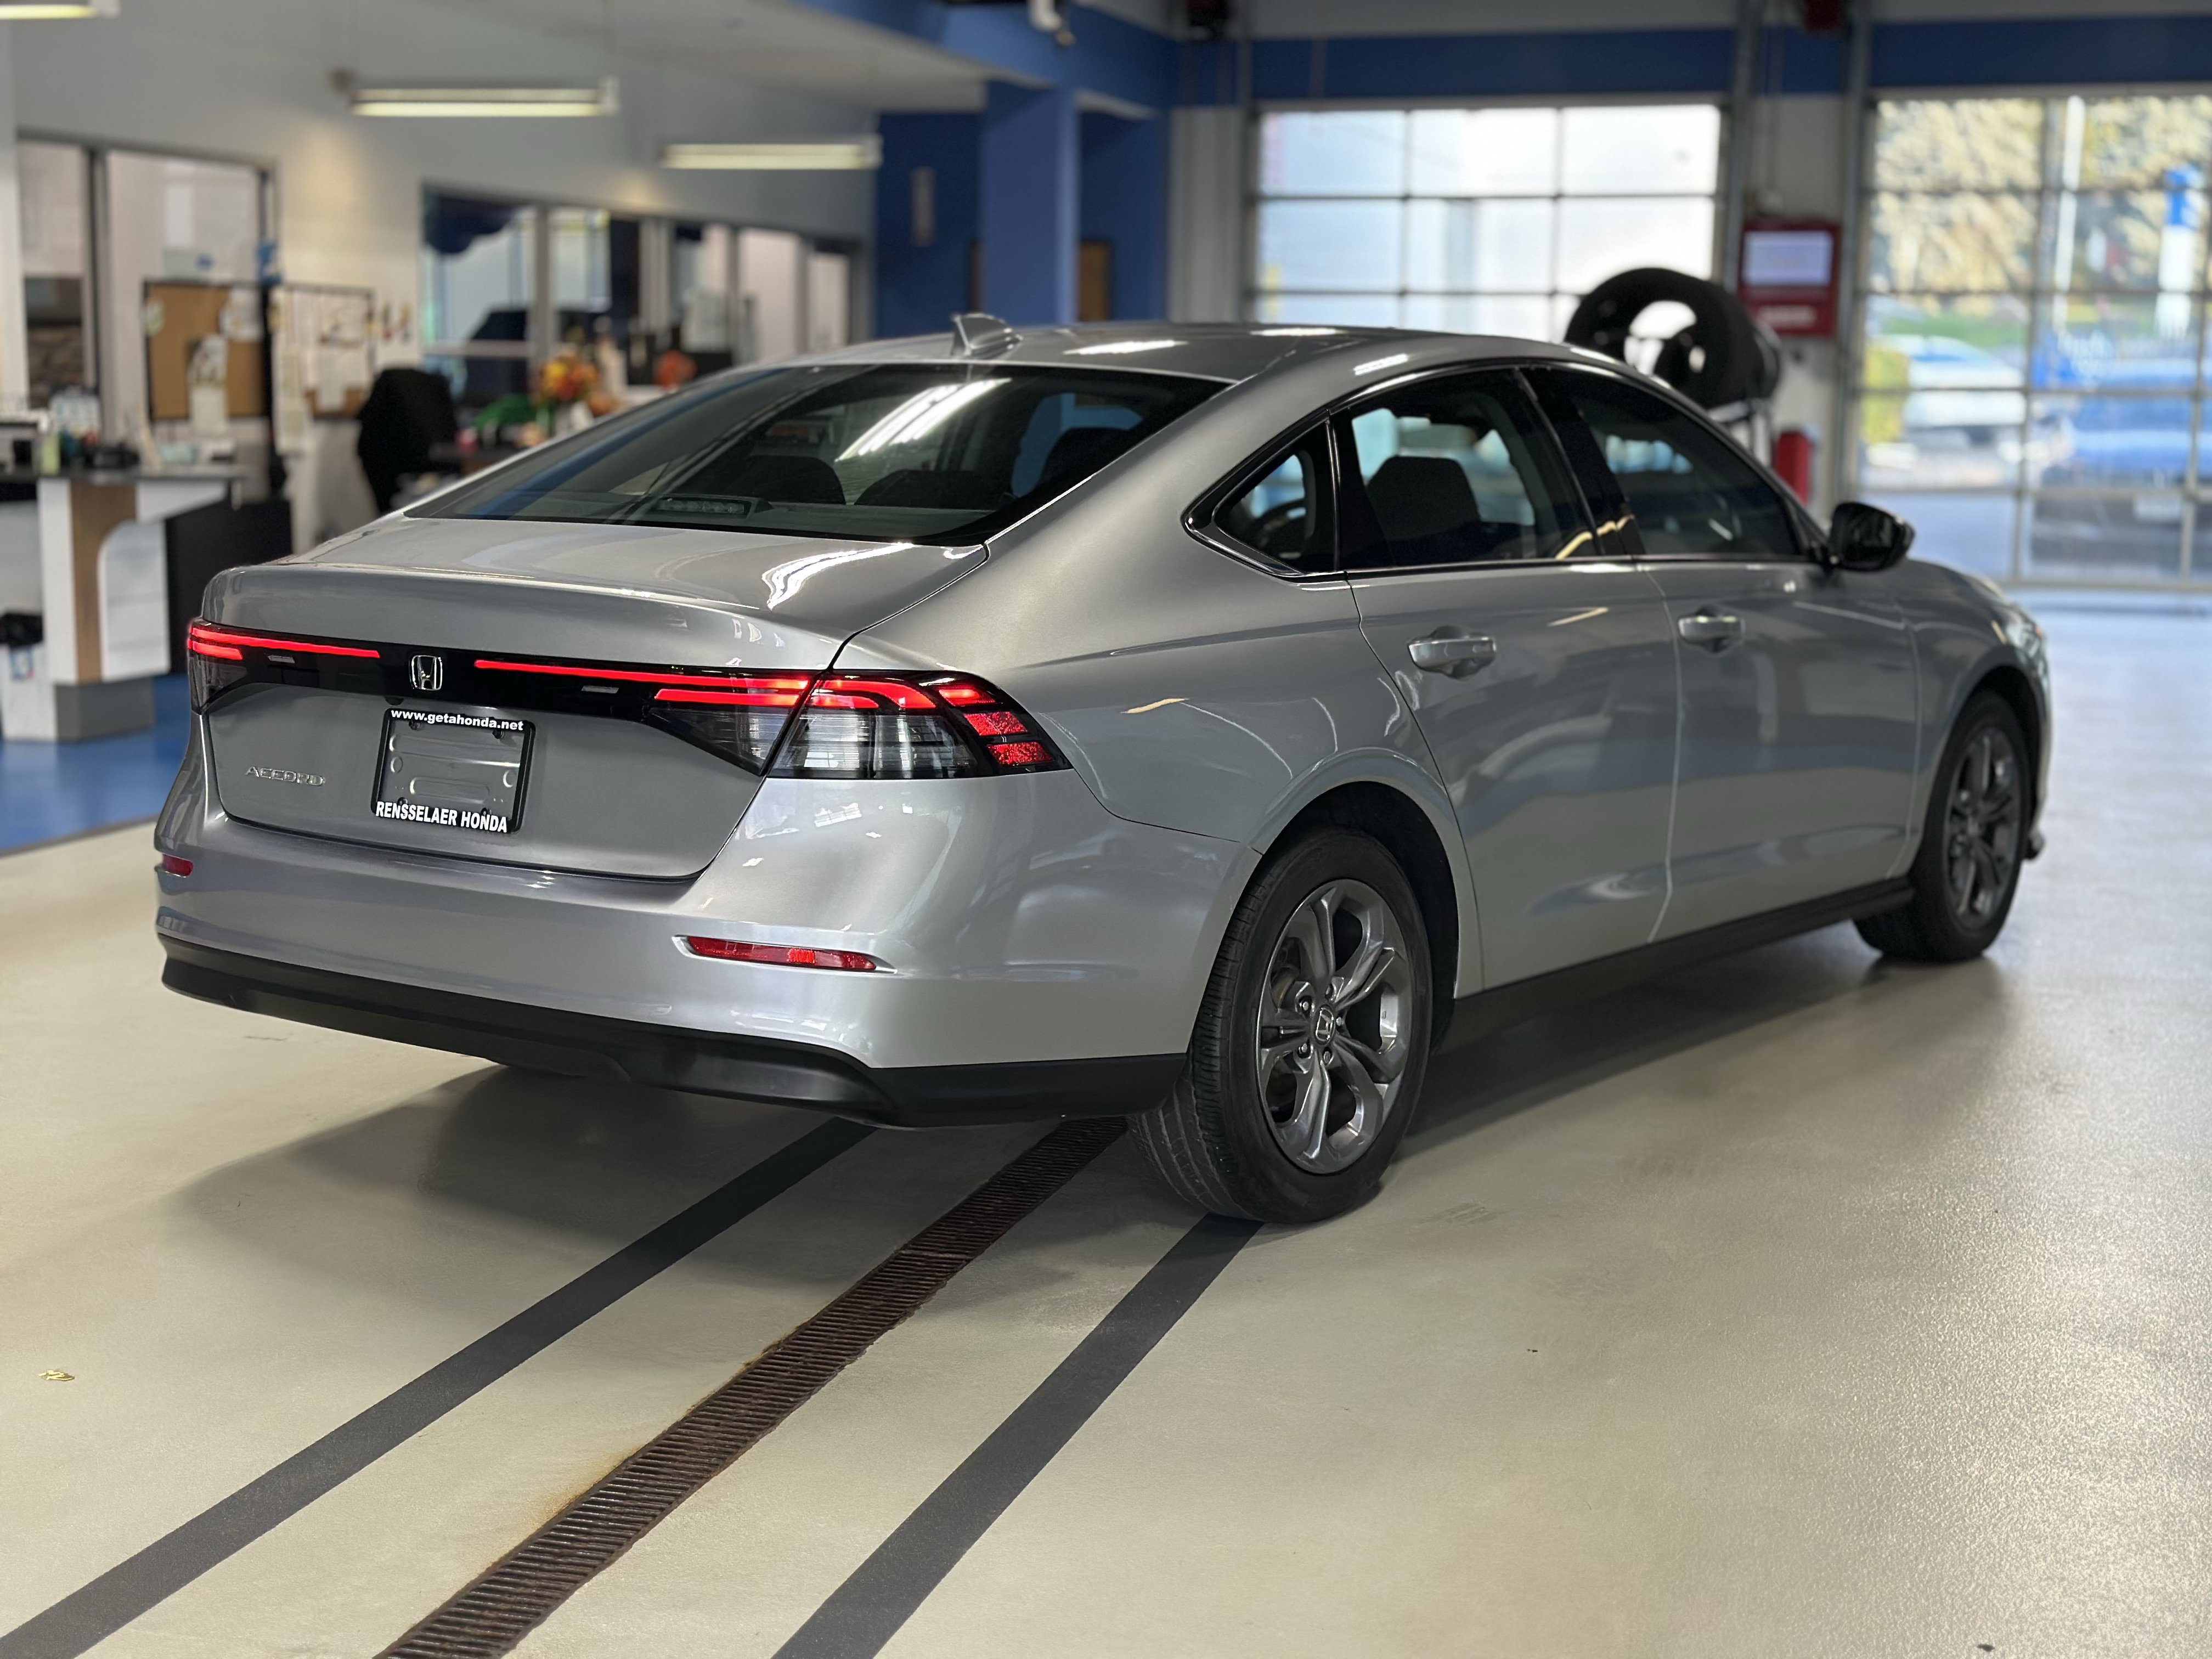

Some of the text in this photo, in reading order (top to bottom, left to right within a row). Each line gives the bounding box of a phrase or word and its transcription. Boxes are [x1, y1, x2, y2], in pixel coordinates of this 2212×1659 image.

[391, 709, 524, 731] www.getahonda.net
[245, 766, 323, 786] ACCORD
[375, 801, 507, 833] RENSSELAER HONDA
